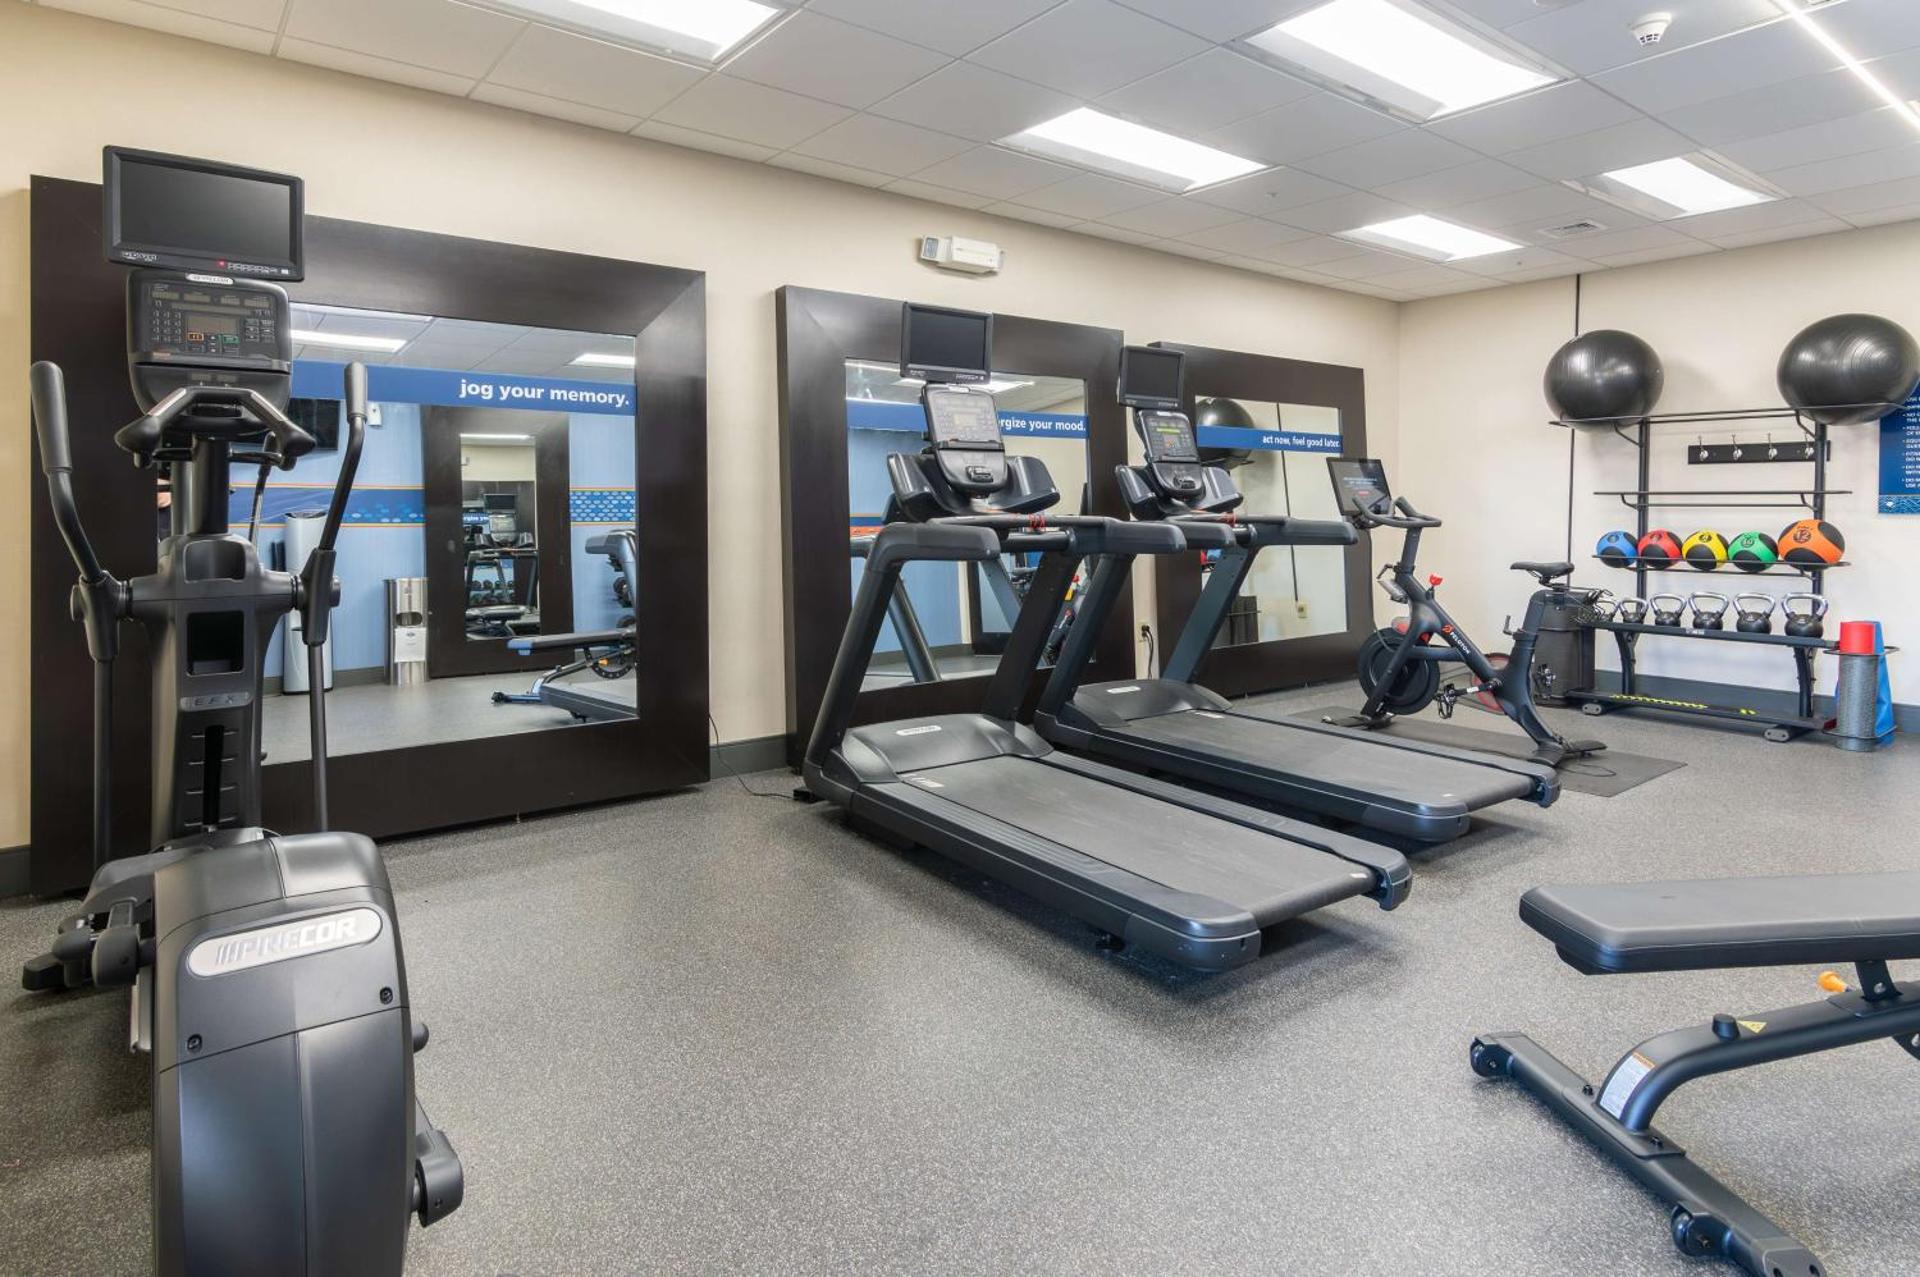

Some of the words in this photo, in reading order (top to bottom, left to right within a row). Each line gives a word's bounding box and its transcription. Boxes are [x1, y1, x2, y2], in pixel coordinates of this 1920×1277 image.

[459, 379, 494, 400] jog
[499, 384, 545, 401] your
[550, 387, 630, 408] memory.
[998, 416, 1027, 431] rgize
[1029, 420, 1053, 431] your
[1055, 420, 1086, 431] mood.
[1262, 435, 1273, 444] act
[1306, 437, 1323, 448] good
[236, 916, 356, 961] PRECOR
